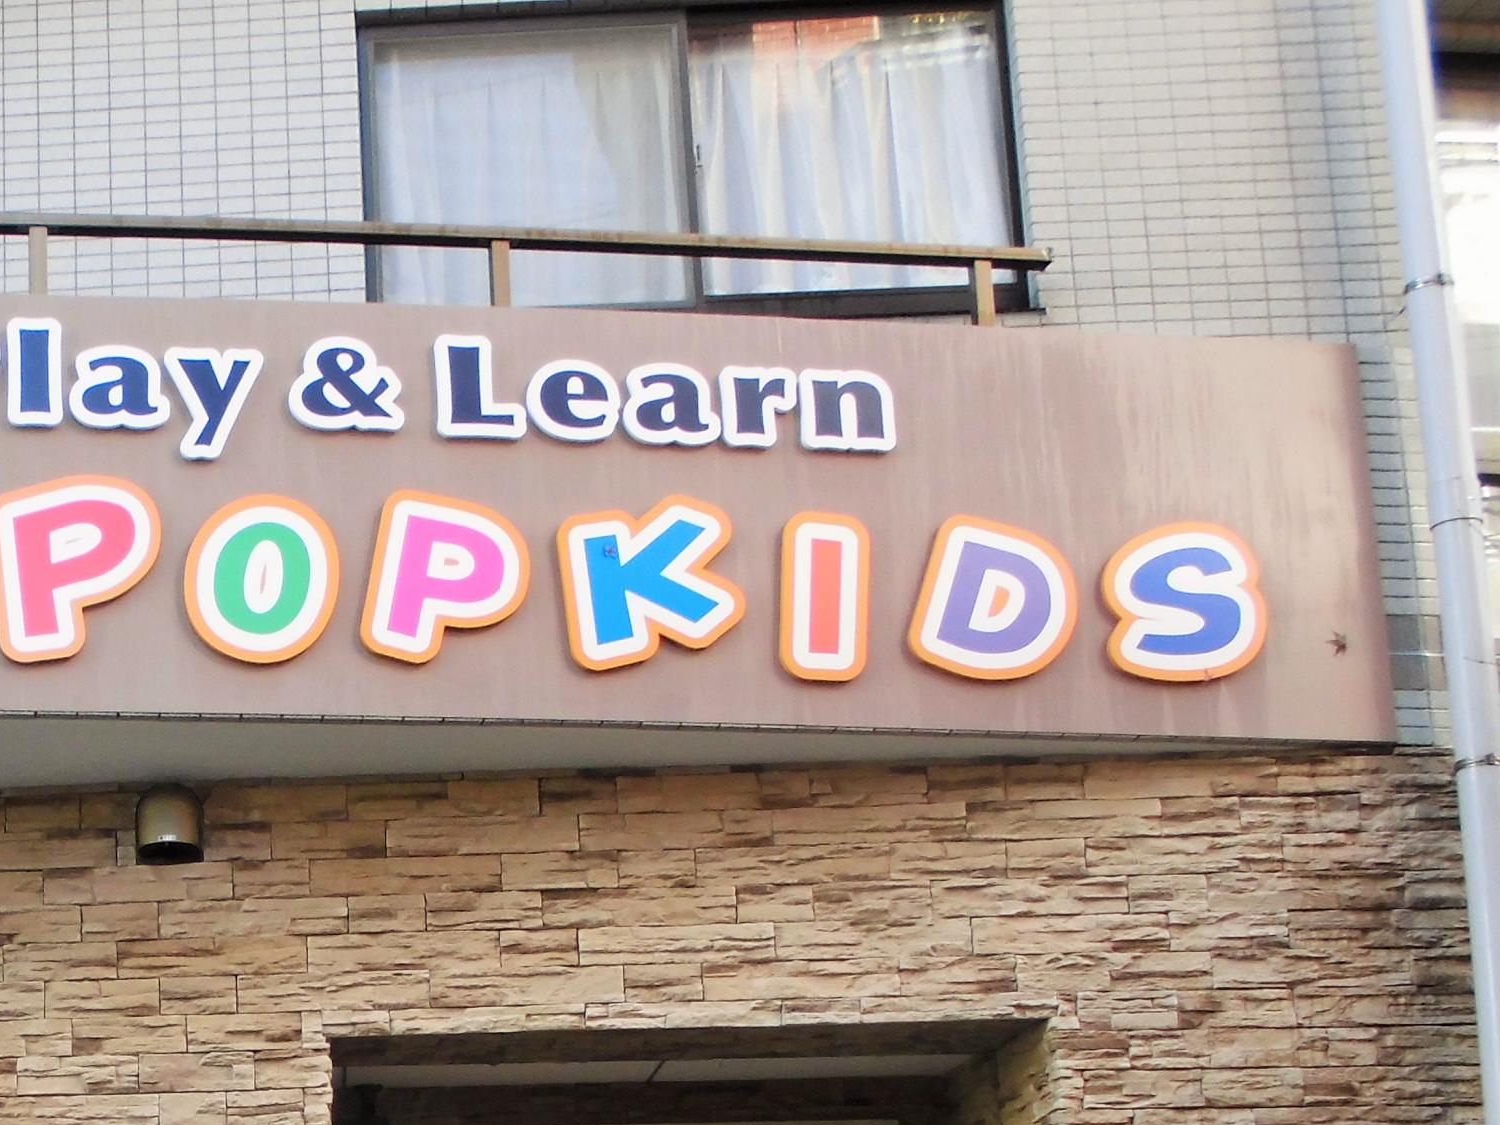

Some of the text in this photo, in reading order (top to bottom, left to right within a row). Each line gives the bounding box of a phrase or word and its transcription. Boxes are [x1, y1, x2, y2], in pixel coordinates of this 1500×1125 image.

[301, 345, 395, 420] &
[445, 343, 888, 441] Learn
[11, 496, 1245, 670] POPKIDS
